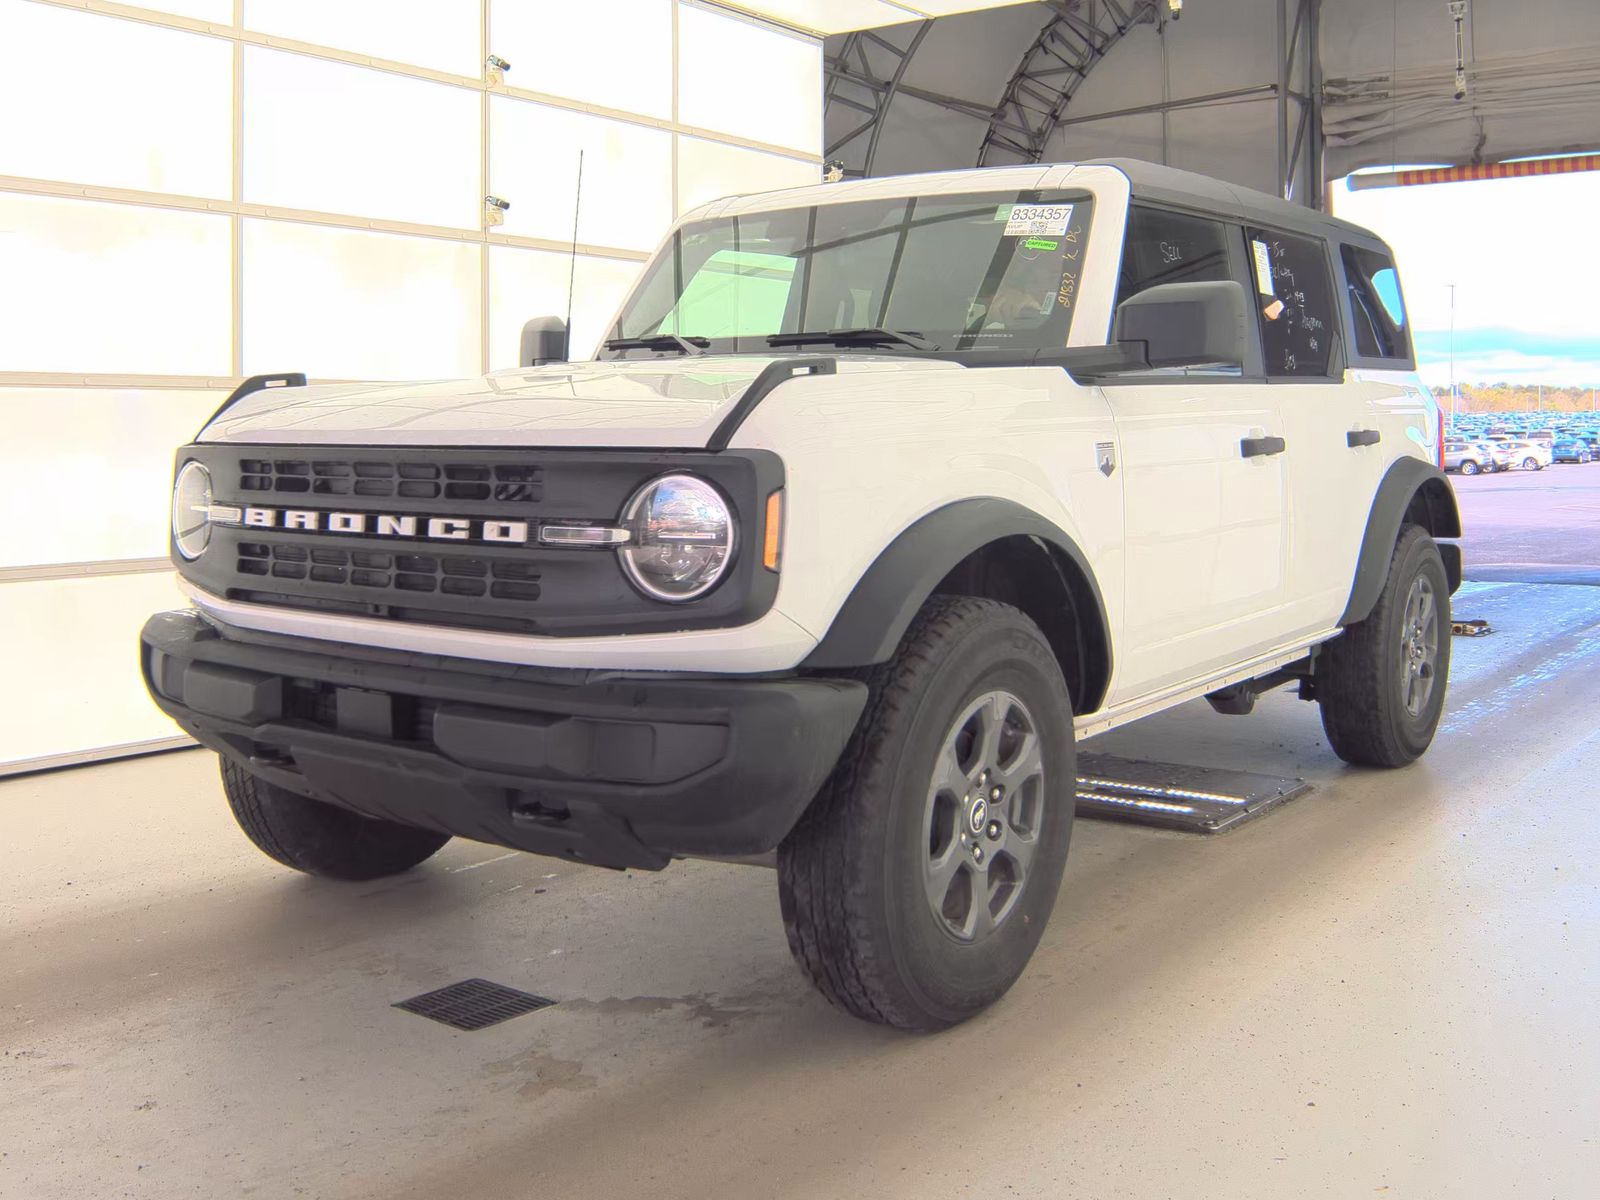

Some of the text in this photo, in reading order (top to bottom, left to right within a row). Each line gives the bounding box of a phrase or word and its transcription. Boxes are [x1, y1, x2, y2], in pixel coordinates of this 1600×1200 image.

[1011, 208, 1071, 220] 8334357
[1027, 240, 1057, 249] CAPTURED
[244, 507, 528, 543] BRONCO
